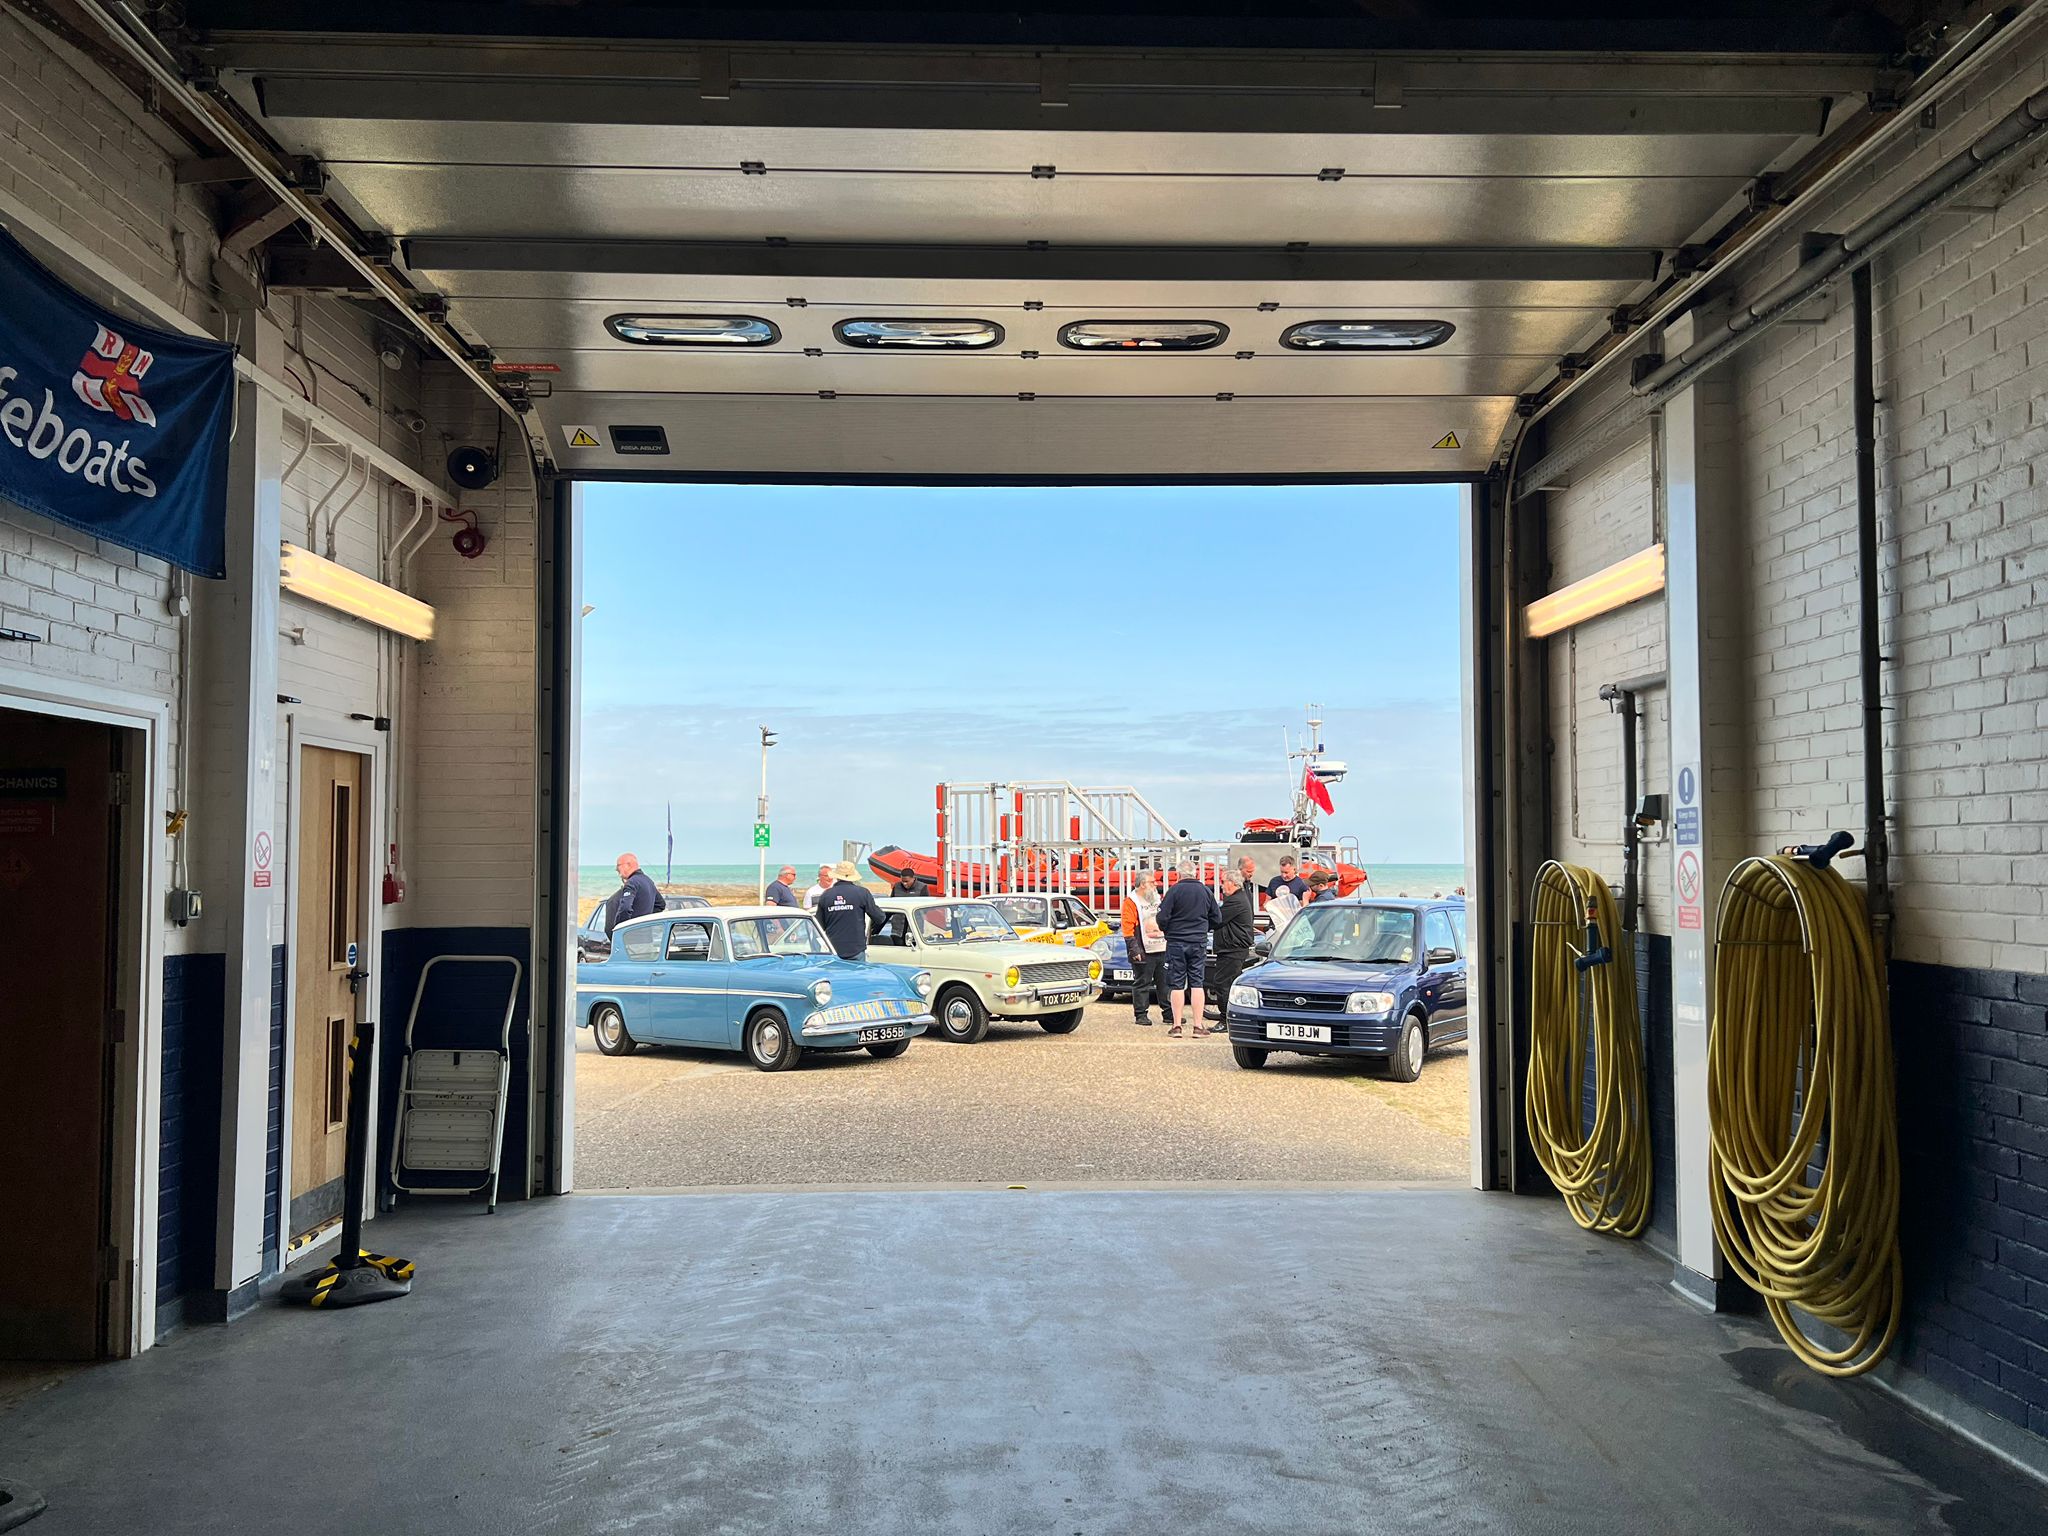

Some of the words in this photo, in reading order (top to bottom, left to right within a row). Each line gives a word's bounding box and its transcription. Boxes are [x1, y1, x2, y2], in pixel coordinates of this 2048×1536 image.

[1043, 994, 1059, 1005] TOX
[1060, 992, 1080, 1003] 725H
[860, 1030, 879, 1042] ASE
[880, 1027, 904, 1040] 355B
[1278, 1025, 1295, 1037] T31
[1298, 1026, 1320, 1039] BJW
